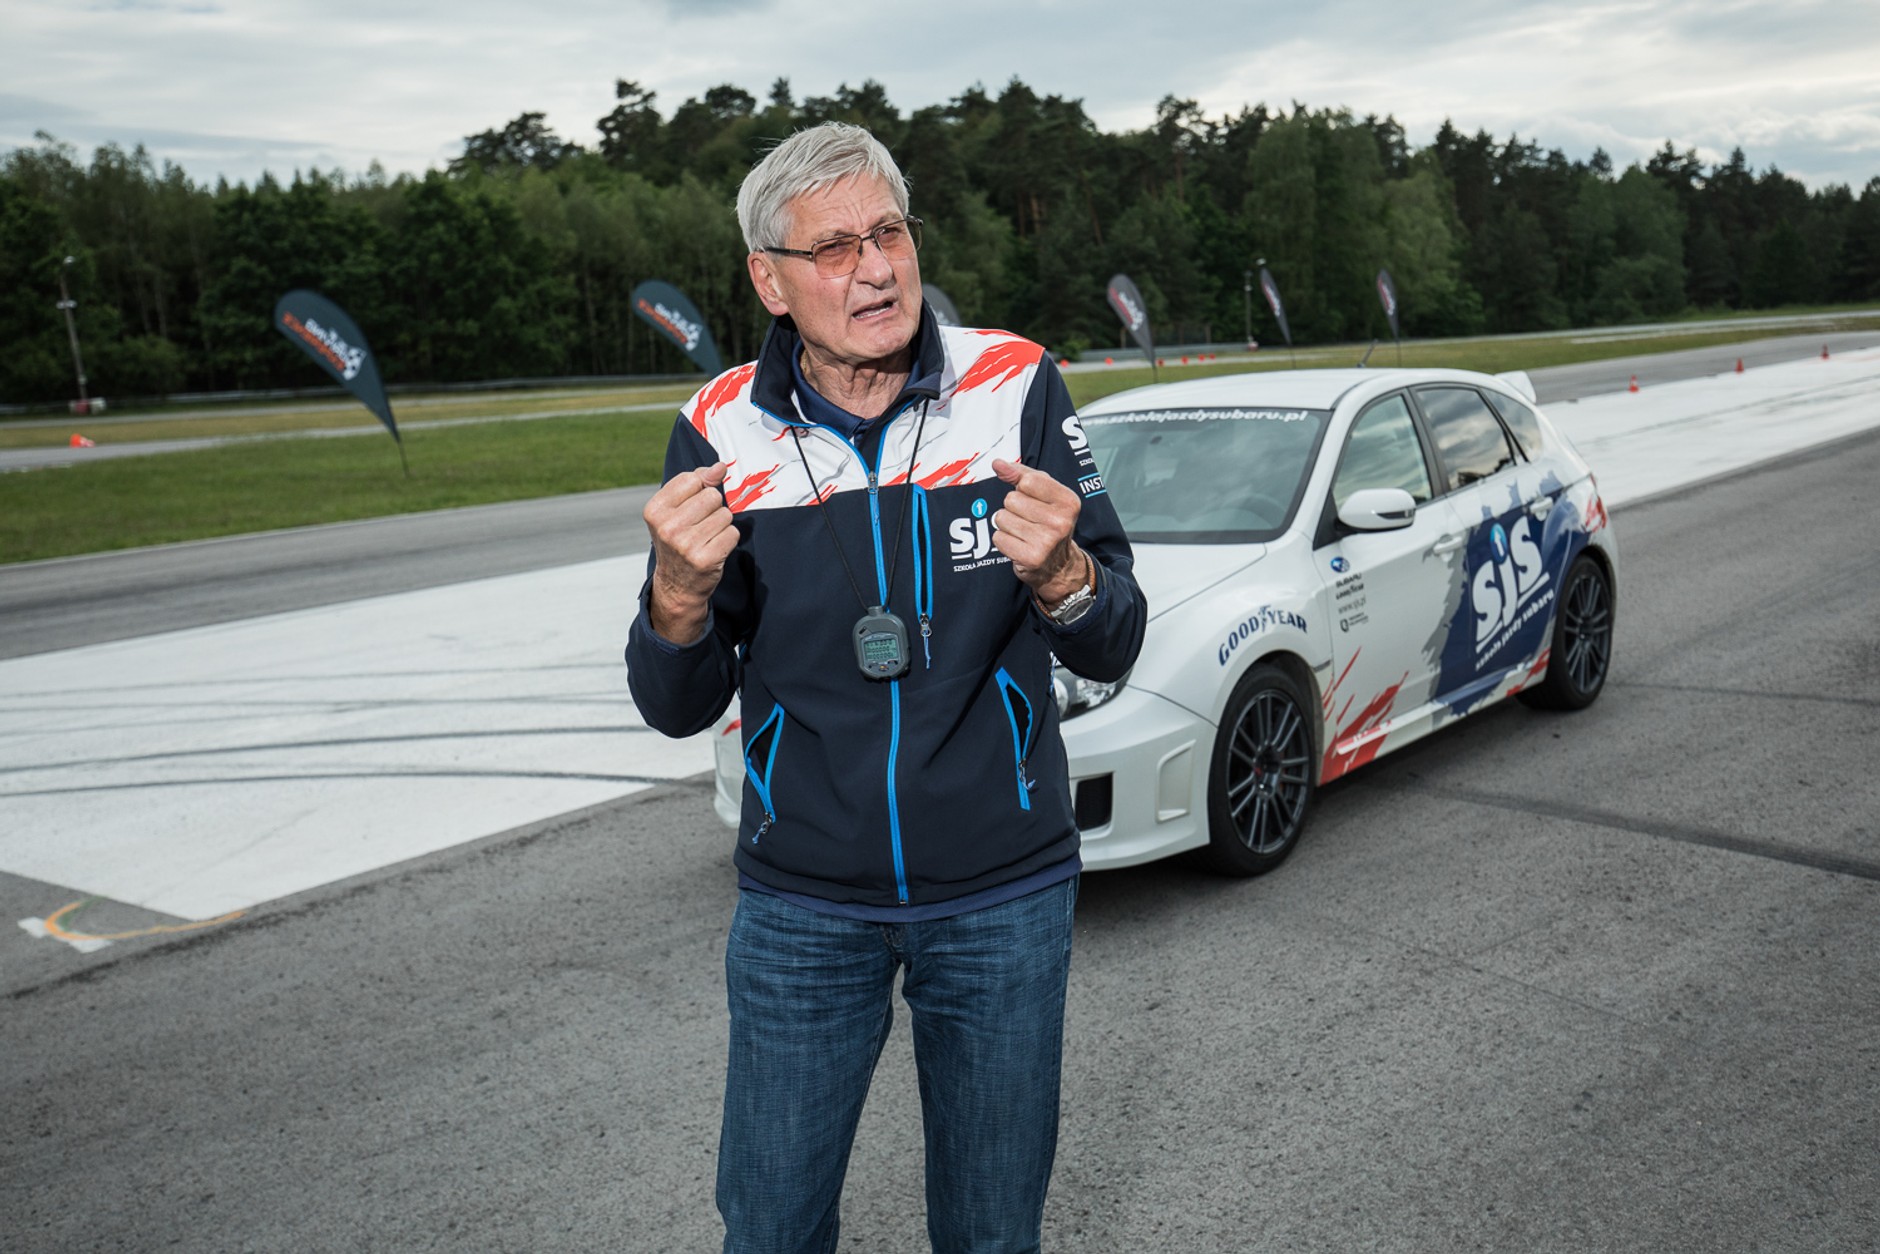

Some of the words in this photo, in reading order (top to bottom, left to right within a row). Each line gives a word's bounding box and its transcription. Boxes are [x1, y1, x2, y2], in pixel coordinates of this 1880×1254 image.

[976, 558, 995, 568] JAZDY
[1522, 588, 1555, 622] subaru
[1218, 607, 1308, 667] GOODYEAR
